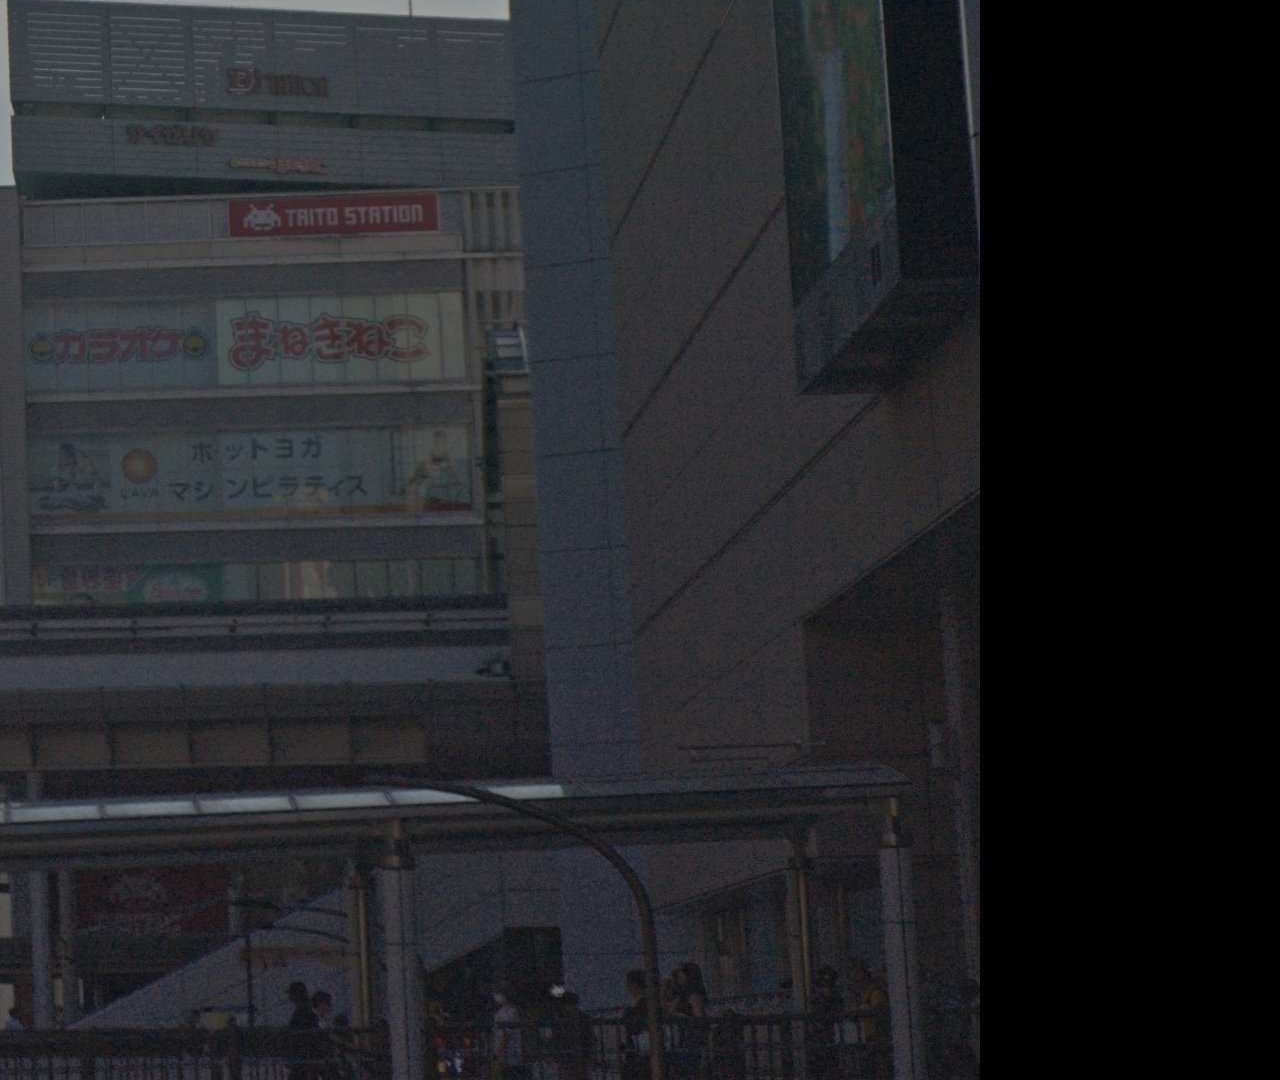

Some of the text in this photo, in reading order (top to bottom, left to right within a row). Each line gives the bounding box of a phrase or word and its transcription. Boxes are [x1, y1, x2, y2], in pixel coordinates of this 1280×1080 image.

[284, 204, 424, 228] TAITO STATION
[52, 328, 184, 365] カラオケ
[228, 311, 429, 372] まねきねこ
[191, 436, 322, 461] ホットヨガ
[169, 474, 368, 502] マシンピラティス
